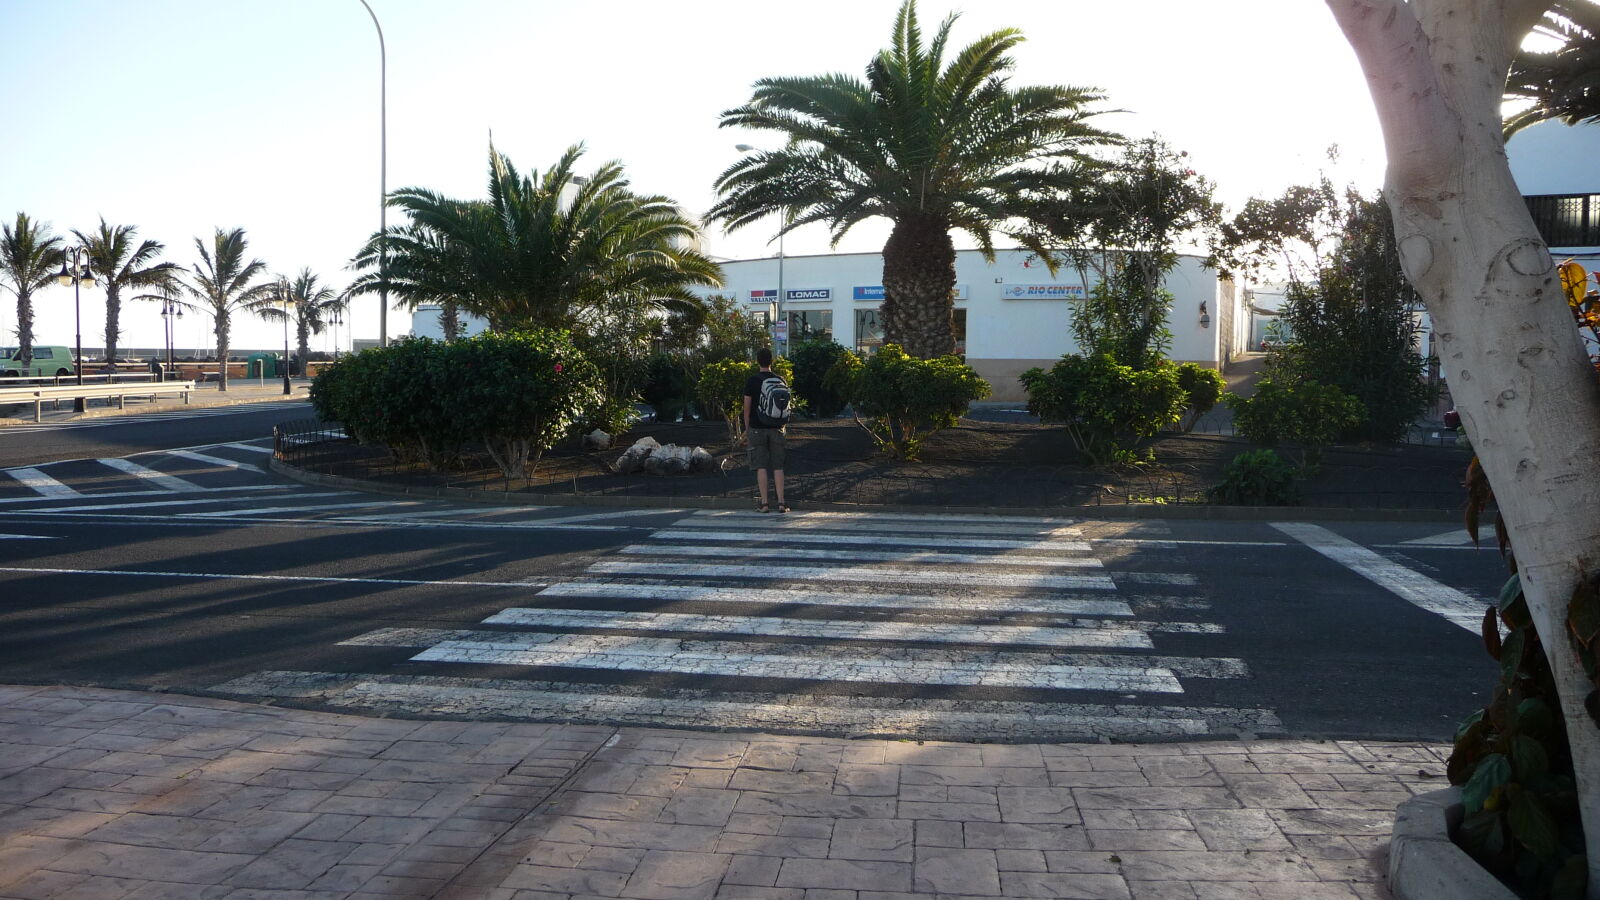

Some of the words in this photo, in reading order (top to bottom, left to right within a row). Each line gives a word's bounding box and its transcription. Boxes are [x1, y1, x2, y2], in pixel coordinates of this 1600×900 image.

[1028, 286, 1046, 294] RIO
[1047, 286, 1083, 294] CENTER
[790, 291, 827, 299] LOMAC
